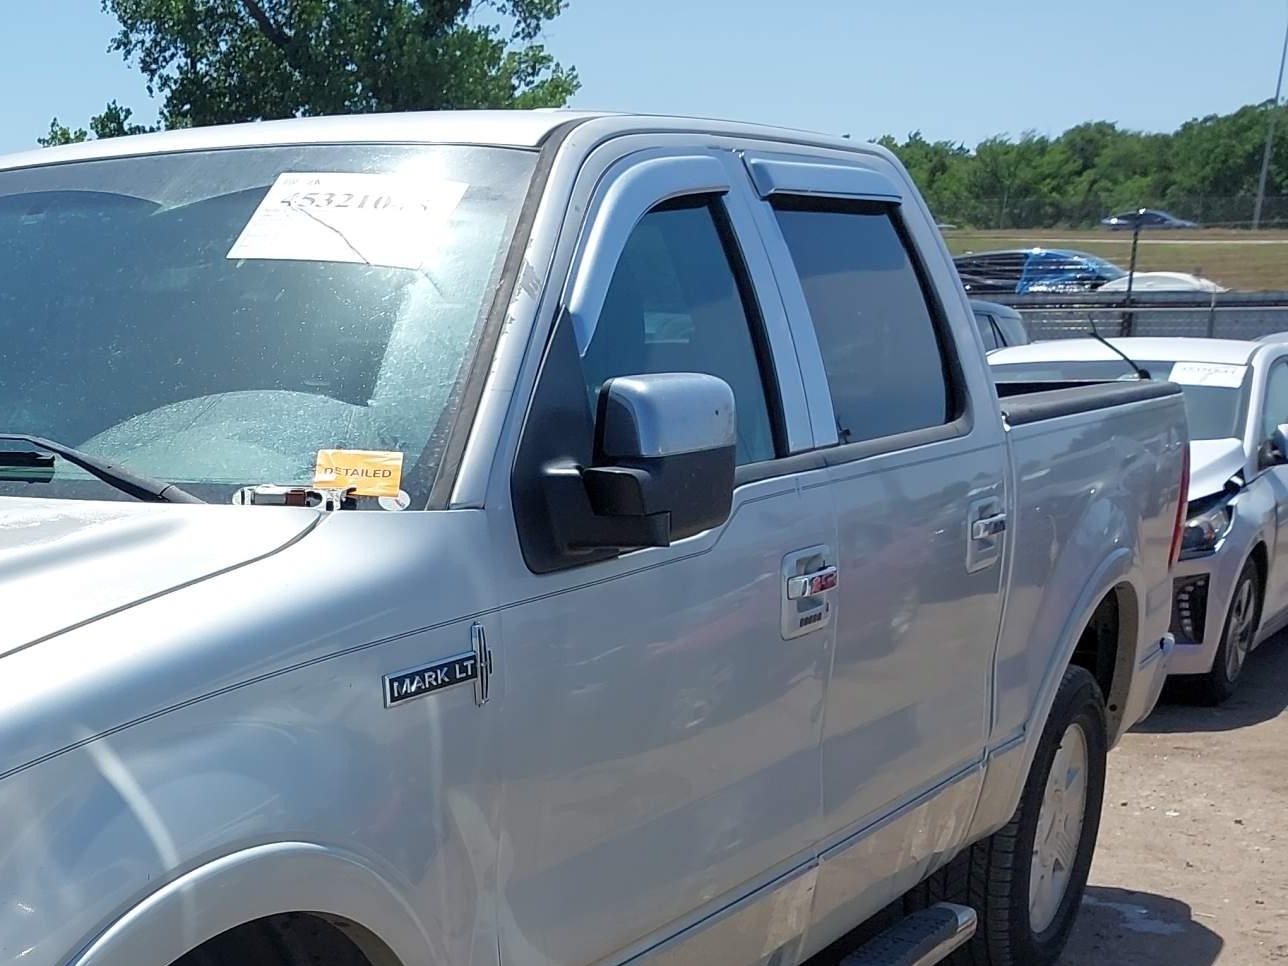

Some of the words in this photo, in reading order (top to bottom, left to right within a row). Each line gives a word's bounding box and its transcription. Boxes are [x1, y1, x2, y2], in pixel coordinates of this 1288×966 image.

[323, 466, 393, 479] DETAILED
[392, 667, 451, 698] MARK
[455, 659, 476, 679] LT
